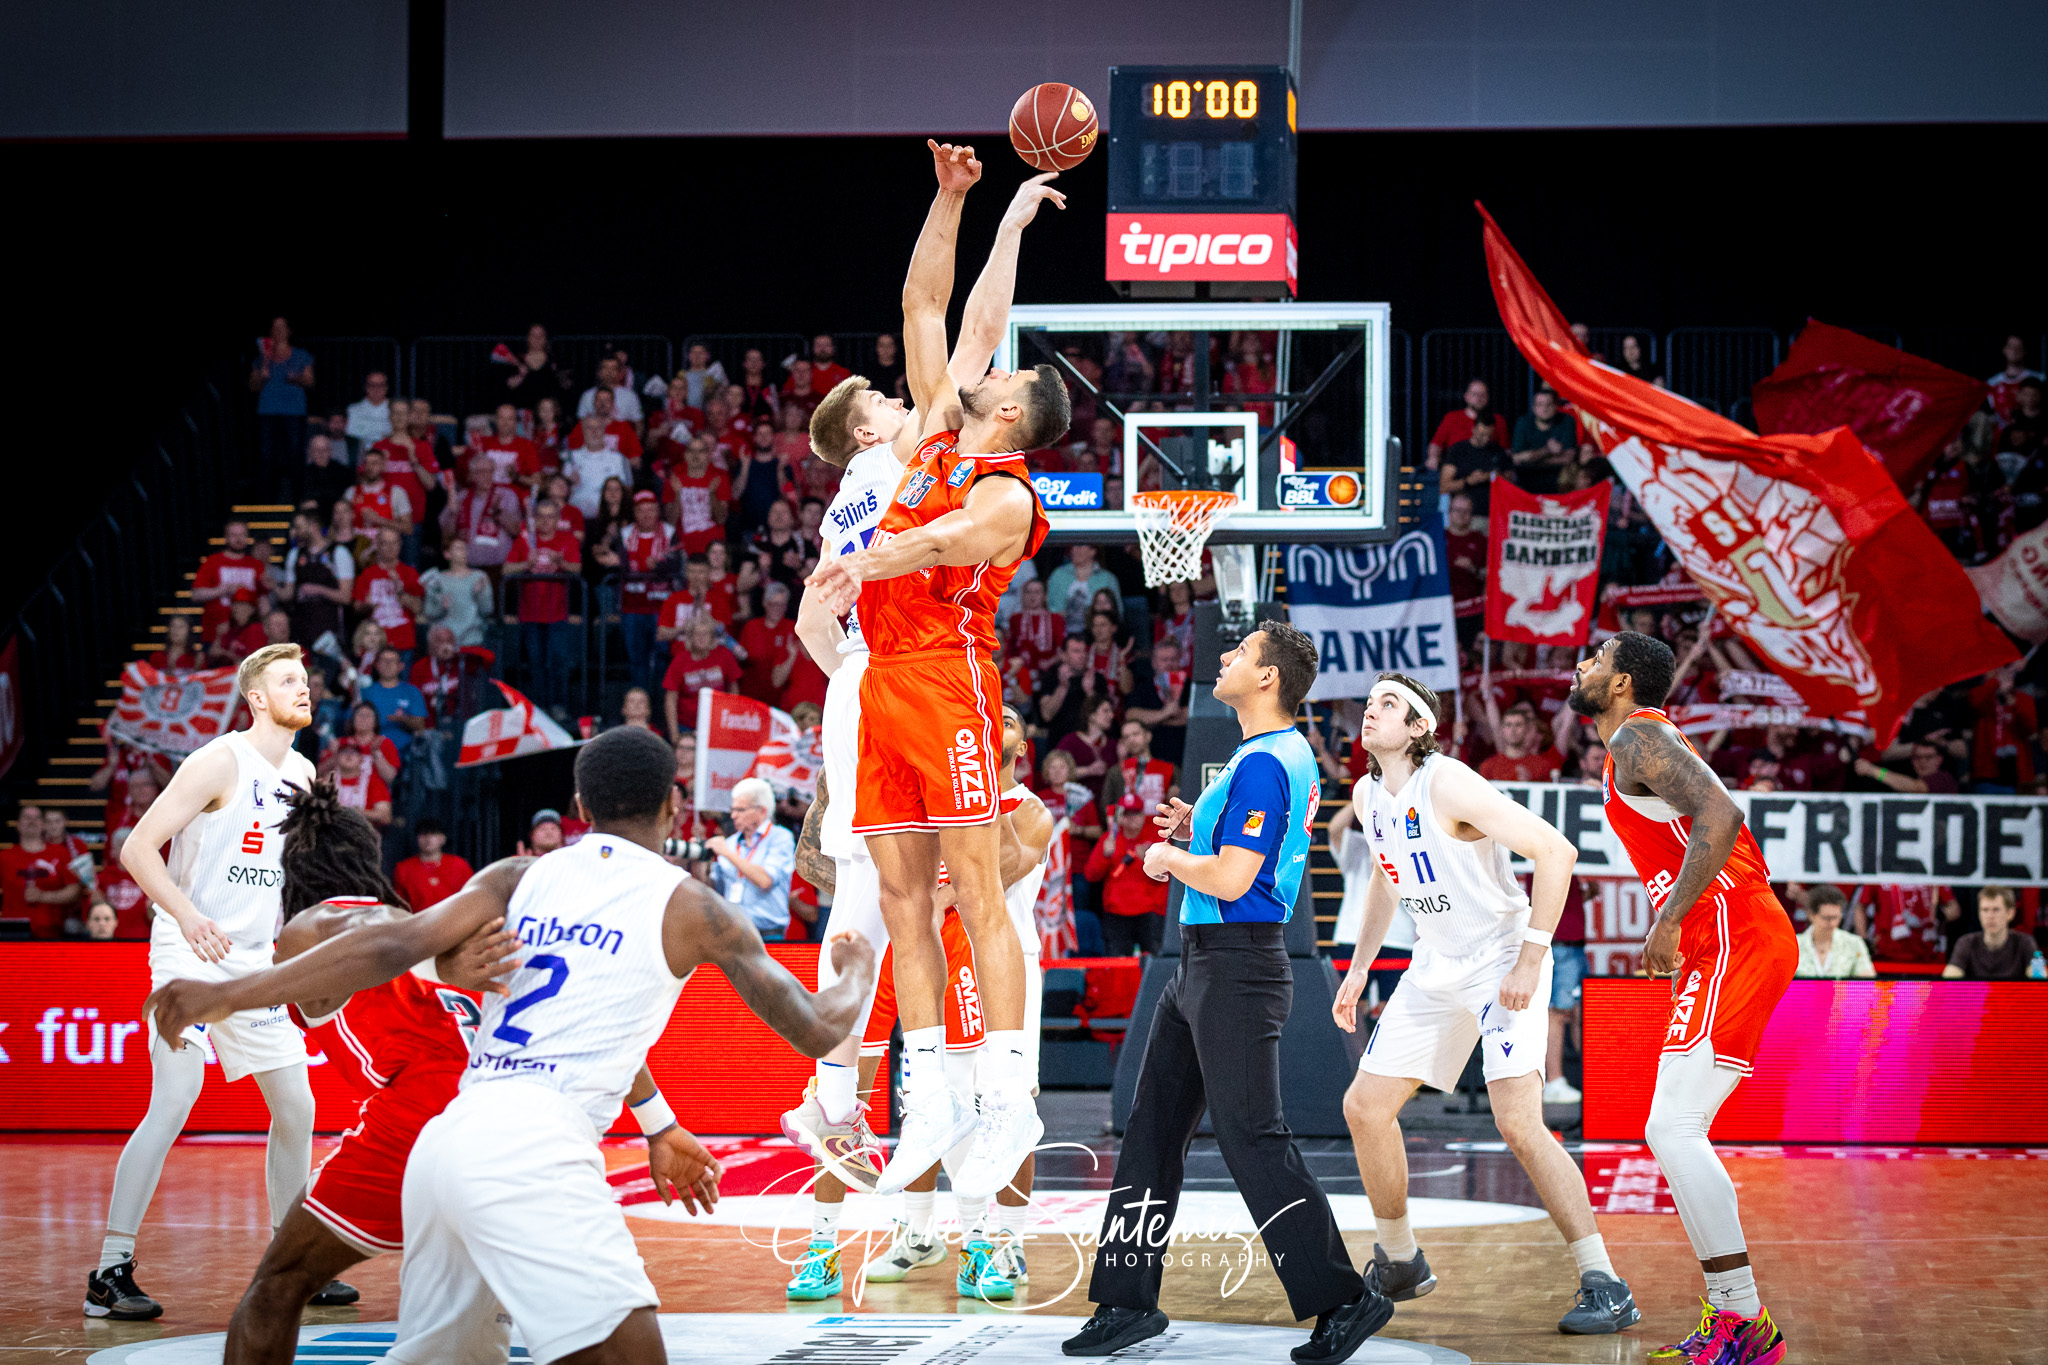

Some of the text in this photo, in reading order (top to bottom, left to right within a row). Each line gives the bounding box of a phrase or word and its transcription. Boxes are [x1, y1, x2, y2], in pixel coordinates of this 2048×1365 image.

[1119, 221, 1274, 273] tipico
[1045, 489, 1098, 506] Credit
[1284, 489, 1320, 504] BBL
[1301, 623, 1446, 673] ANKE
[1750, 797, 2048, 880] FRIEDE
[1410, 851, 1437, 884] 11
[516, 915, 624, 955] Gibson
[492, 953, 570, 1046] 2
[35, 1006, 140, 1064] für
